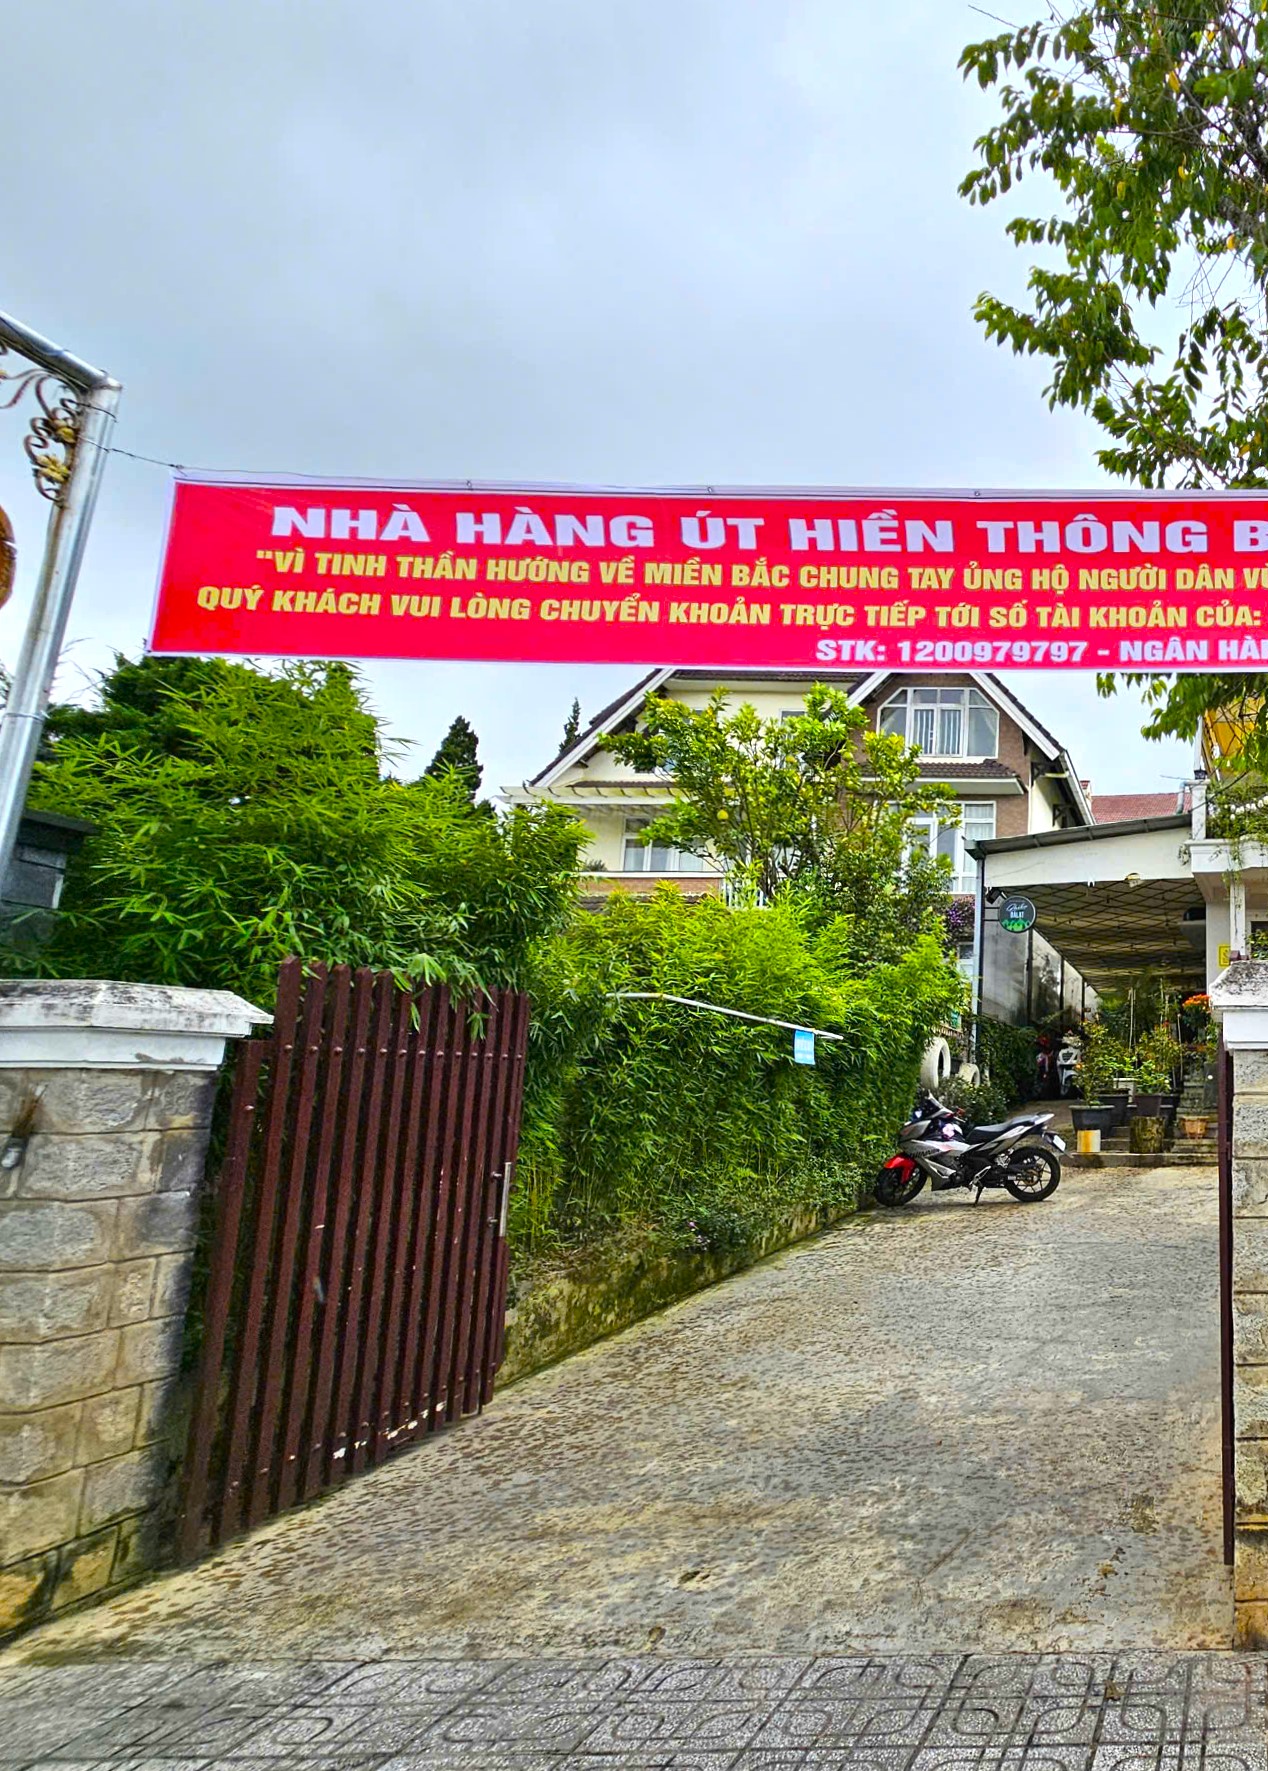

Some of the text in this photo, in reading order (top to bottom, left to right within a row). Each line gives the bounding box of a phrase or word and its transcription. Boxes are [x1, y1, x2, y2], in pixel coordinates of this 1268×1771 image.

[271, 503, 430, 542] NHÀ
[456, 506, 654, 547] HÀNG
[681, 510, 765, 550] ÚT
[788, 509, 954, 552] HIỀN
[976, 513, 1208, 553] THÔNG
[314, 552, 387, 577] TINH
[396, 550, 478, 580] THẦN
[486, 556, 590, 583] HƯỚNG
[599, 555, 635, 584] VỀ
[644, 556, 722, 586] MIỀN
[731, 557, 790, 588] BẮC
[799, 565, 899, 589] CHUNG
[907, 567, 955, 589] TAY
[963, 560, 1023, 590] ỦNG
[1031, 563, 1070, 595] HỘ
[1078, 563, 1167, 591] NGƯỜI
[1176, 563, 1235, 590] DÂN
[197, 584, 264, 611] QUÝ
[272, 588, 381, 615] KHÁCH
[391, 594, 441, 617] VUI
[450, 592, 531, 620] LÒNG
[539, 592, 660, 622] CHUYỂN
[668, 596, 771, 625] KHOẢN
[779, 603, 855, 631] TRỰC
[864, 599, 926, 627] TIẾP
[934, 602, 980, 628] TỚI
[988, 599, 1028, 628] SỐ
[1035, 602, 1080, 628] TÀI
[1089, 599, 1187, 628] KHOẢN
[1196, 599, 1261, 627] CỦA:
[815, 639, 886, 661] STK:
[897, 640, 1088, 662] 1200979797
[1119, 636, 1209, 662] NGÂN
